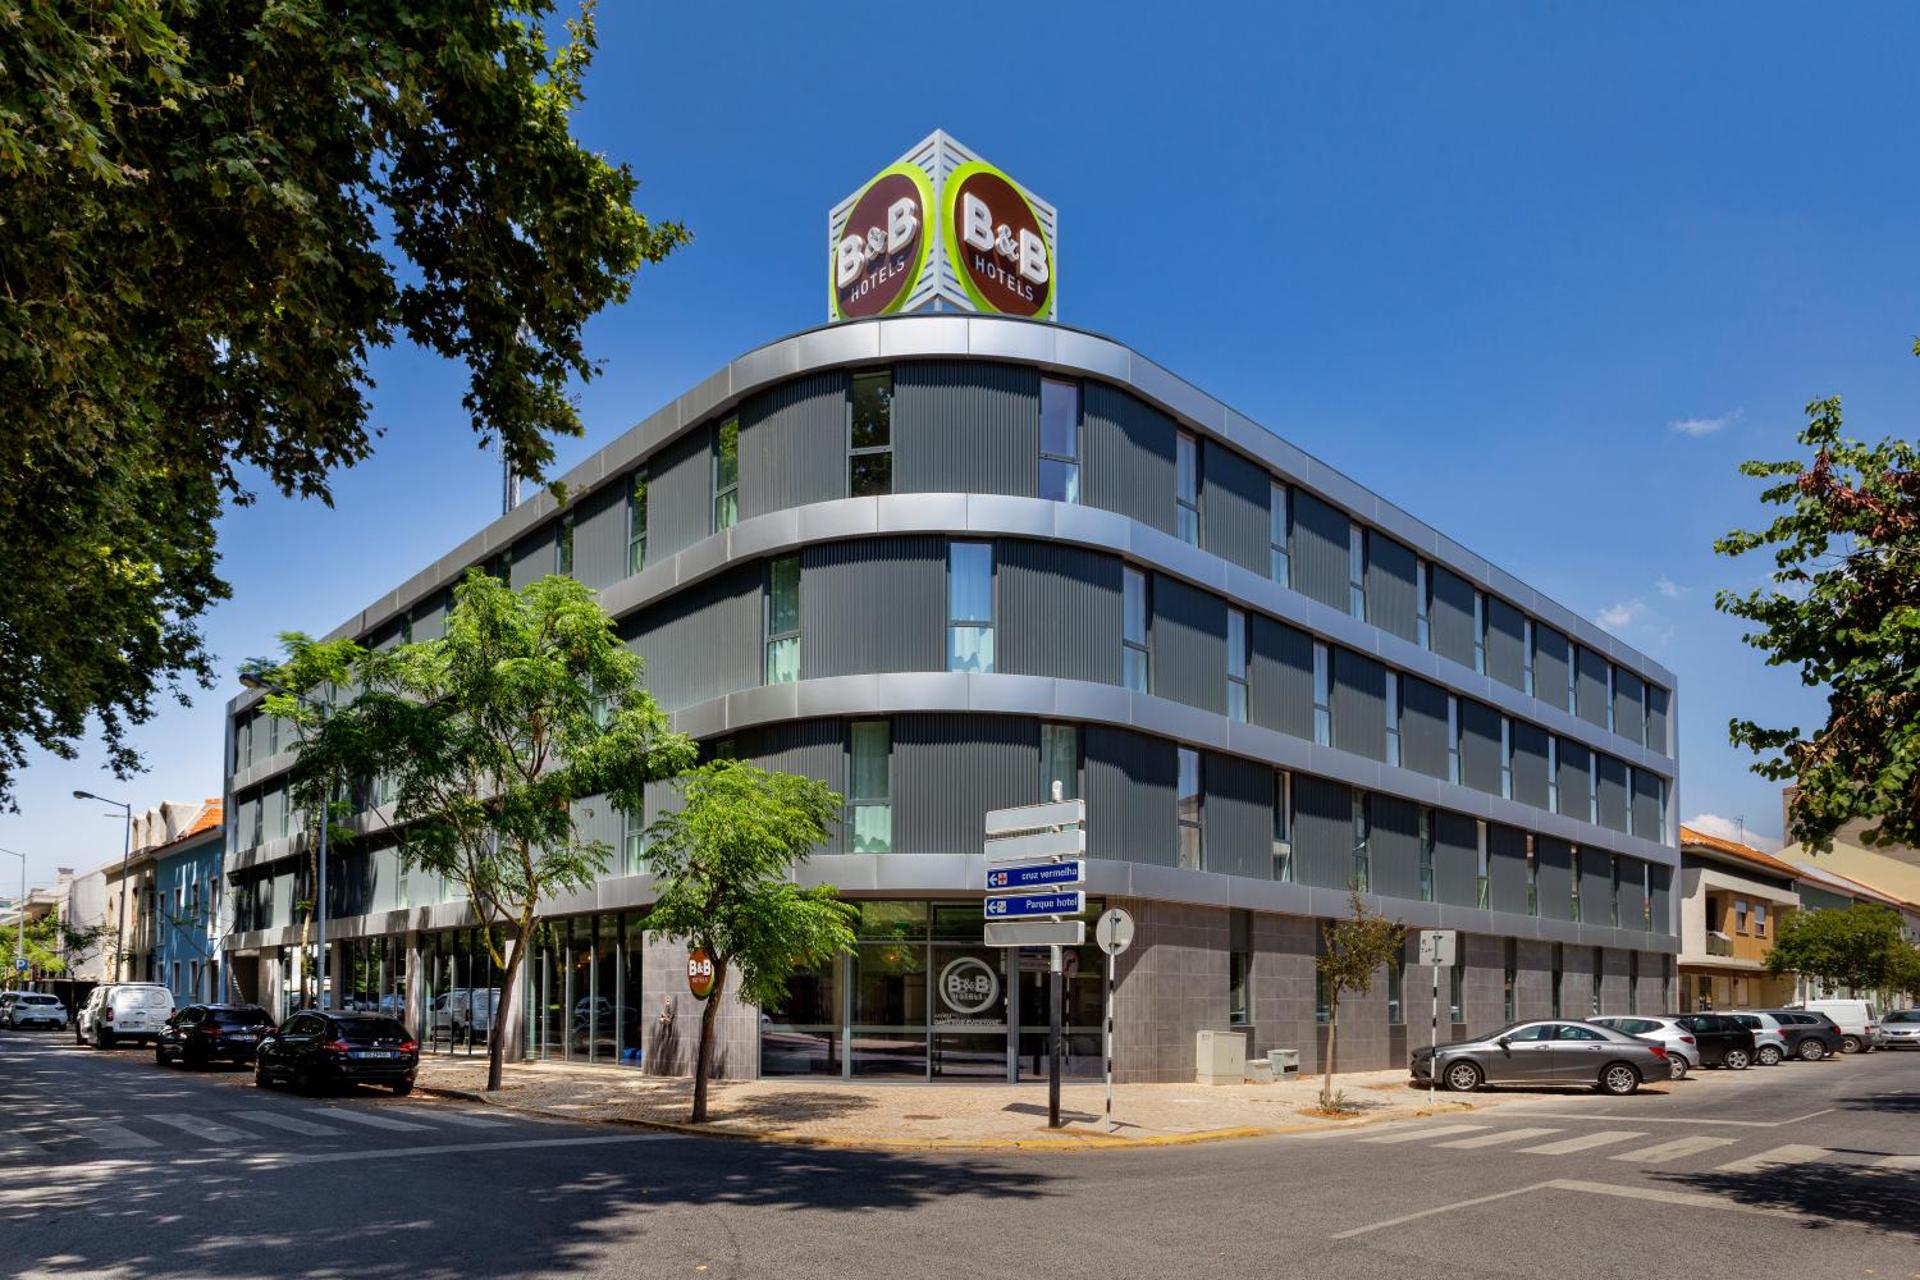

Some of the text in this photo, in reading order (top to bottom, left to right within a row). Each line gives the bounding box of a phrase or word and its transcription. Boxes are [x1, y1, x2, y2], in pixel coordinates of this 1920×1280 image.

[837, 197, 918, 289] B&B
[964, 192, 1049, 285] B&B
[851, 255, 905, 302] HOTELS
[975, 254, 1034, 302] HOTELS
[1021, 867, 1077, 880] cruz vermelha
[1026, 896, 1078, 910] Parque hotel
[16, 959, 26, 970] P
[689, 959, 711, 976] B&B
[948, 975, 989, 993] B&B
